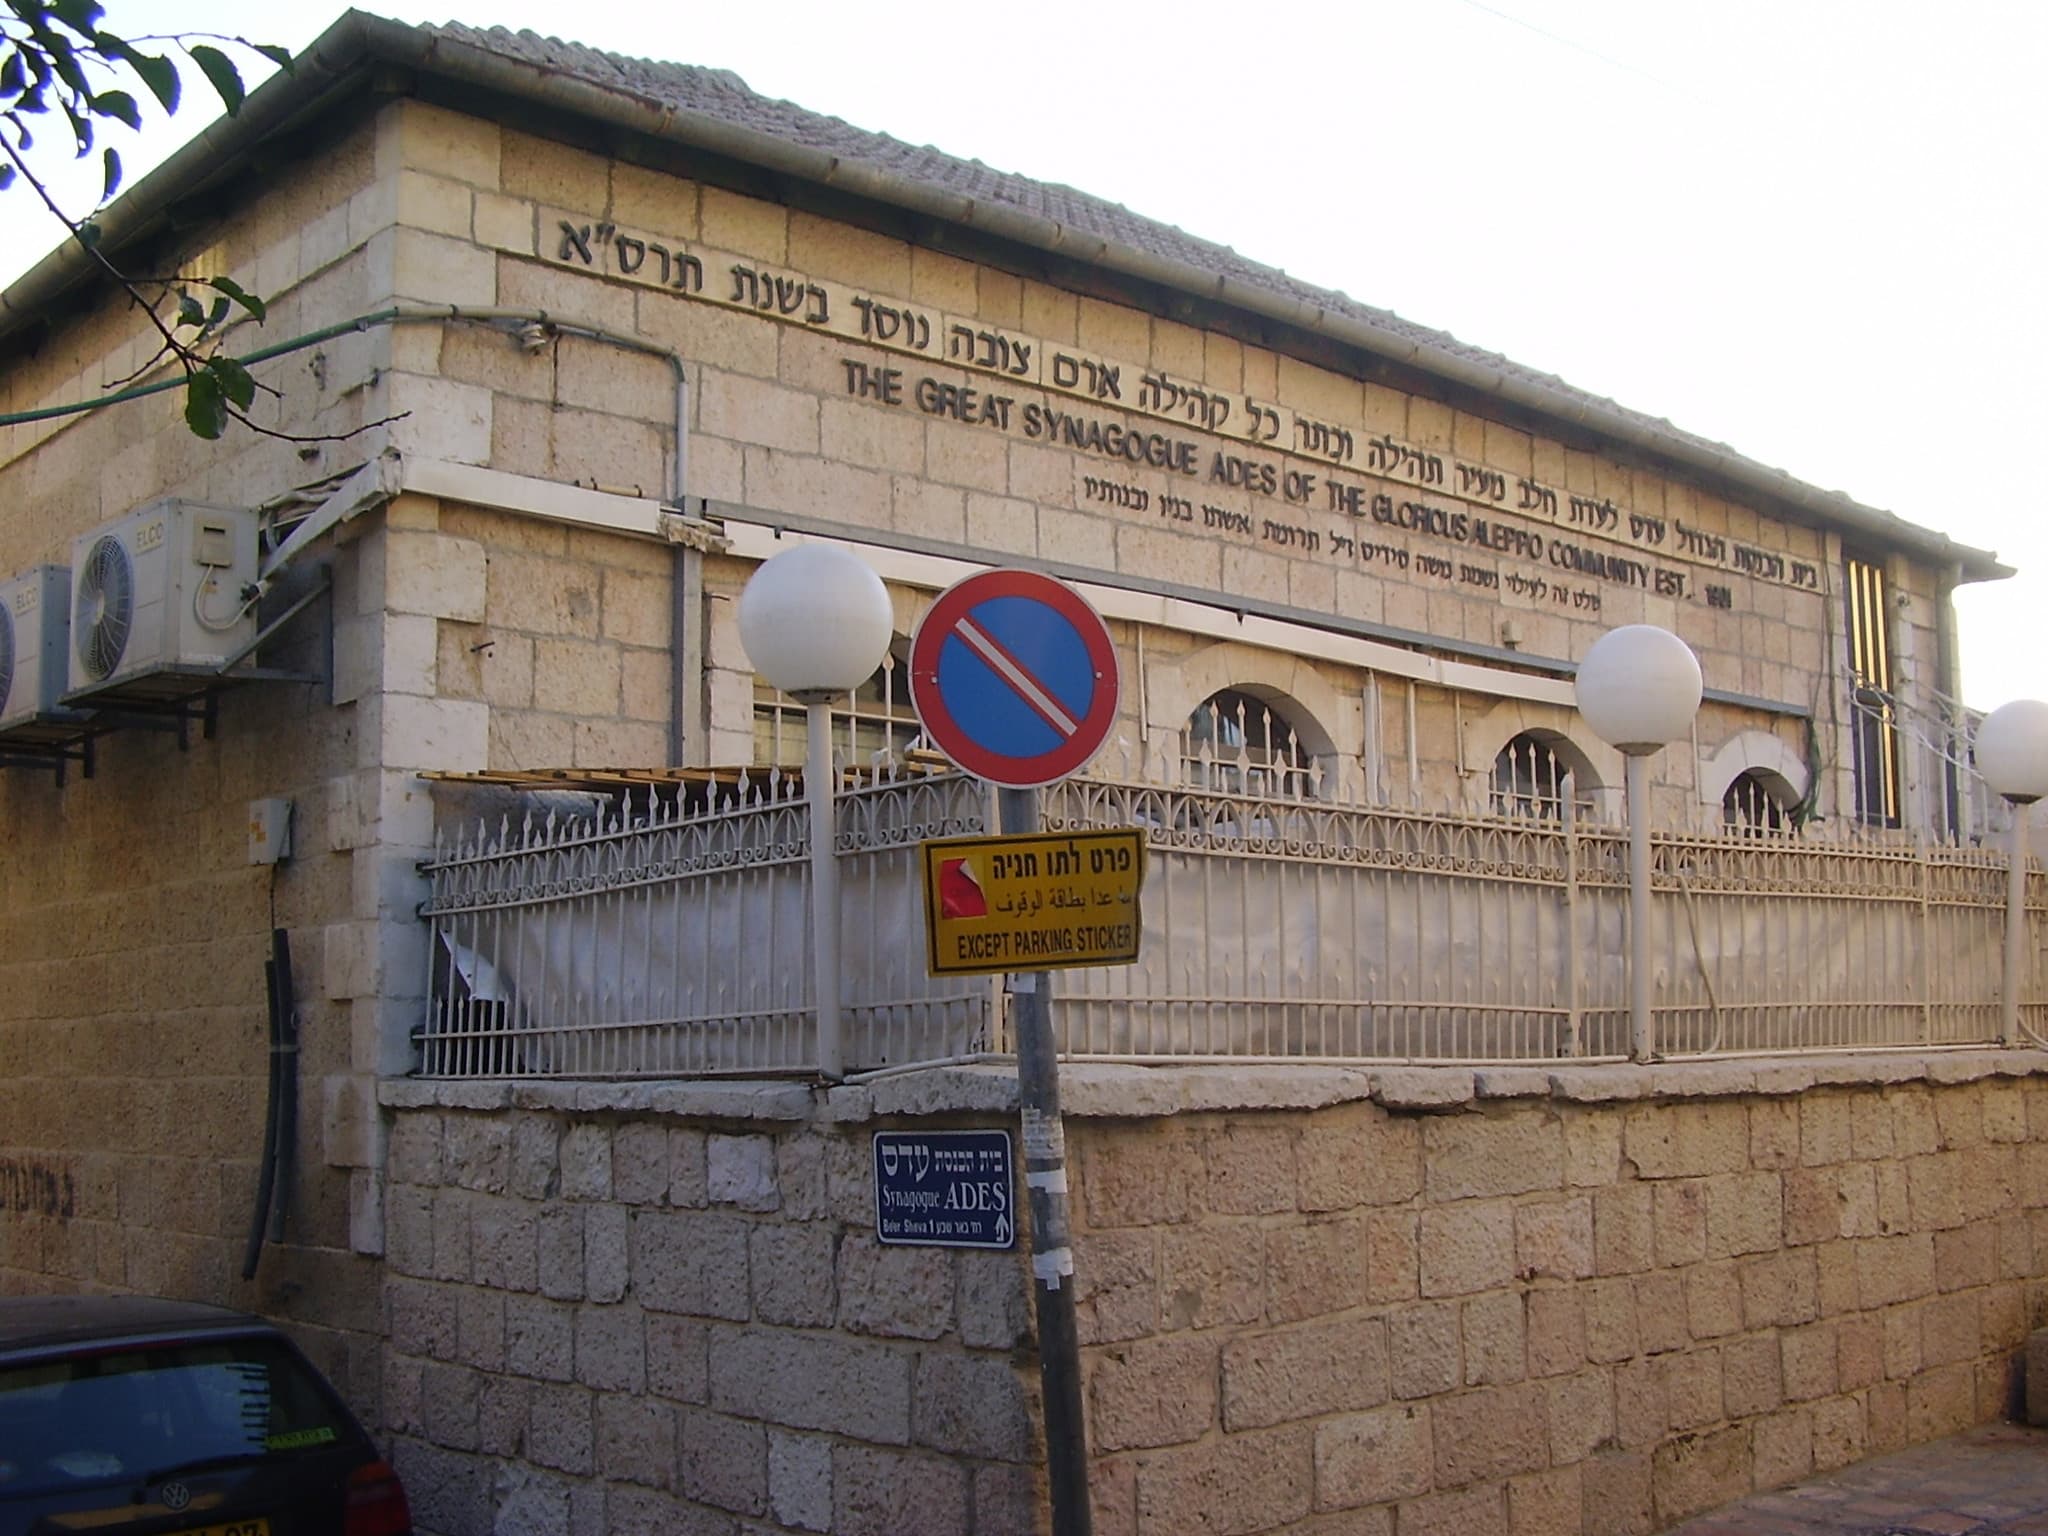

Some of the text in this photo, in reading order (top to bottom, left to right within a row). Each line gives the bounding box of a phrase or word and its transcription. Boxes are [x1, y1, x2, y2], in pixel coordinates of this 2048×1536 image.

[558, 218, 703, 292] תרס"א
[730, 264, 829, 323] בשנת
[851, 296, 930, 349] נוסד
[951, 323, 1031, 375] צובה
[1053, 352, 1121, 399] ארם
[1139, 372, 1230, 432] קהילה
[1246, 396, 1280, 440] כל
[1295, 417, 1353, 460] וכתר
[841, 358, 902, 404] THE
[915, 377, 1014, 430] GREAT
[1023, 403, 1198, 475] SYNAGOGUE
[1209, 451, 1276, 495] ADES
[1284, 471, 1316, 502] OF
[1326, 479, 1366, 517] THE
[1371, 494, 1468, 542] GLORIOUS
[1469, 518, 1543, 560] ALEPPO
[1549, 540, 1650, 588] COMMUNITY
[1368, 435, 1443, 485] תהילה
[1084, 476, 1149, 511] ובנותיו
[1456, 462, 1506, 500] מעיר
[1518, 477, 1557, 516] חלב
[1159, 494, 1193, 521] בניו
[1202, 504, 1250, 534] אשתו
[1569, 496, 1619, 532] לעדת
[1263, 518, 1320, 551] תרומת
[1629, 513, 1666, 545] עדס
[1675, 519, 1726, 562] הגדול
[1416, 553, 1452, 580] משה
[1459, 563, 1499, 590] נשמת
[1791, 561, 1817, 588] בית
[993, 841, 1131, 879] פרט לתו חניה
[958, 924, 1131, 960] EXCEPT PARKING STICKER
[881, 1144, 1003, 1183] בית הכנסת עדס
[883, 1182, 1005, 1213] Synagogue ADES
